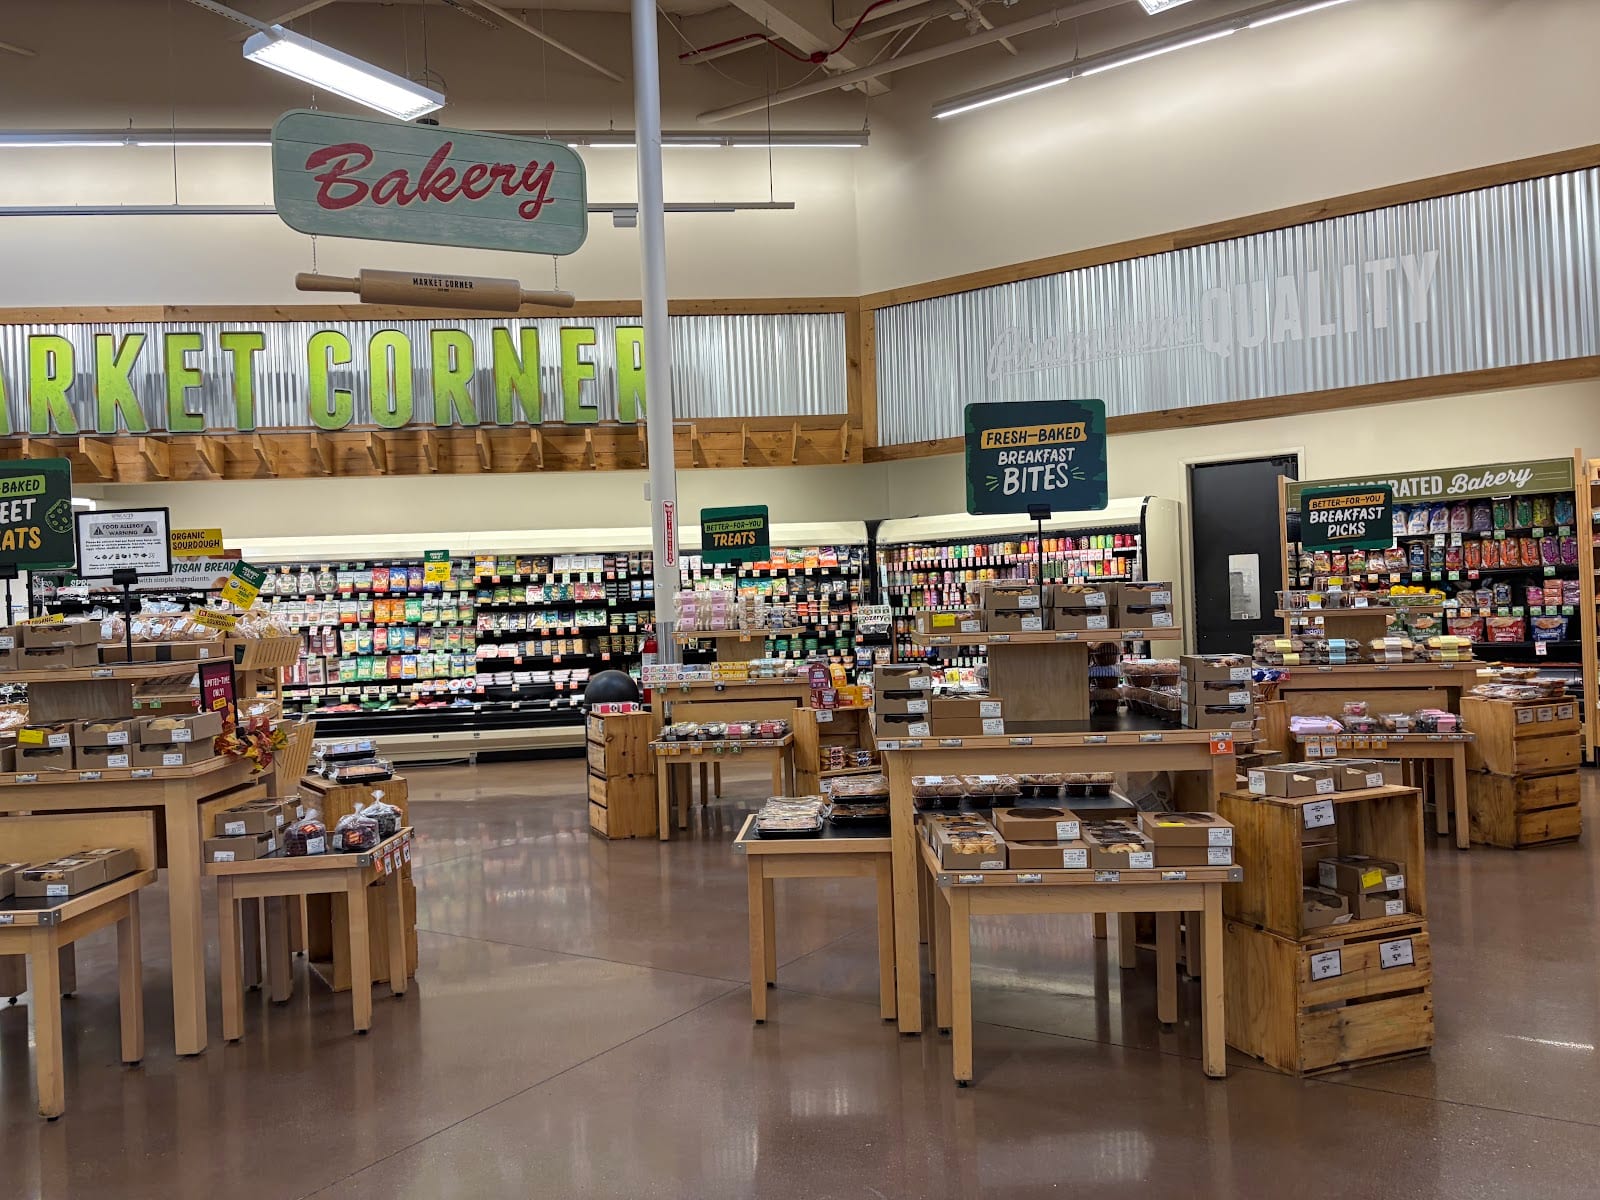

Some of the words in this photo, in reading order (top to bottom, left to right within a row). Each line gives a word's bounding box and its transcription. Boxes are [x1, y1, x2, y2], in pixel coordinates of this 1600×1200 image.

[305, 140, 555, 220] Bakery
[412, 277, 442, 287] MARKET
[445, 279, 474, 289] CORNER
[1200, 250, 1440, 358] QUALITY
[0, 331, 265, 436] RKET
[307, 324, 647, 430] CORNER
[998, 447, 1076, 466] BREAKFAST
[1002, 462, 1070, 496] BITES
[1446, 467, 1534, 495] Bakery
[1312, 495, 1381, 509] BETTER-FOR-YOU
[0, 498, 37, 524] EET
[1309, 506, 1385, 524] BREAKFAST
[706, 519, 762, 531] BETTER-FOR-YOU
[1327, 521, 1366, 538] PICKS
[0, 526, 42, 551] ATS
[171, 531, 206, 541] ORGANIC
[172, 539, 220, 550] SOURDOUGH
[713, 530, 756, 547] TREATS
[172, 562, 202, 573] TISAN
[154, 576, 174, 585] simple
